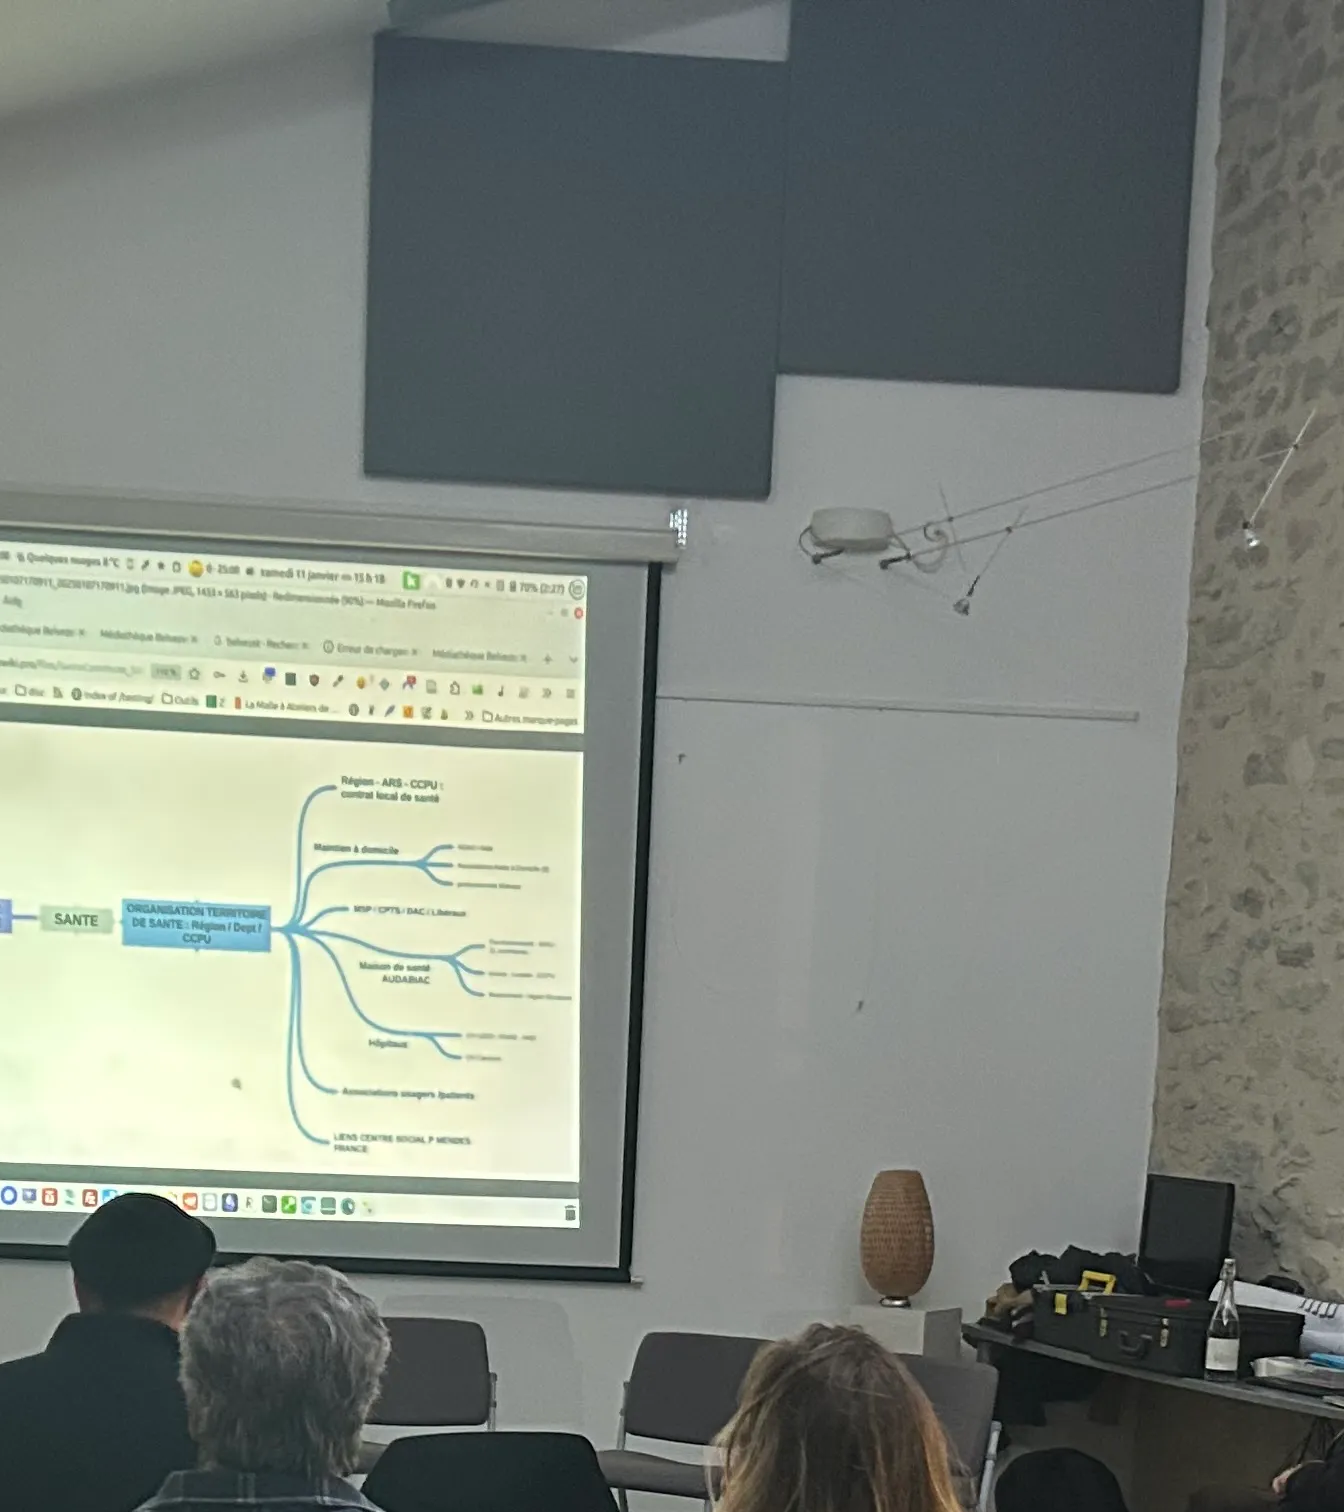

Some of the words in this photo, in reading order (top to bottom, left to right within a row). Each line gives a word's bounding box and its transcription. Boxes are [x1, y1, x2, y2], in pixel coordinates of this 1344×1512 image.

[261, 568, 294, 579] samedi
[307, 570, 339, 583] janvier
[382, 777, 402, 788] ARS
[54, 913, 99, 927] SANTE
[132, 917, 146, 928] DE
[148, 918, 183, 930] SANTE
